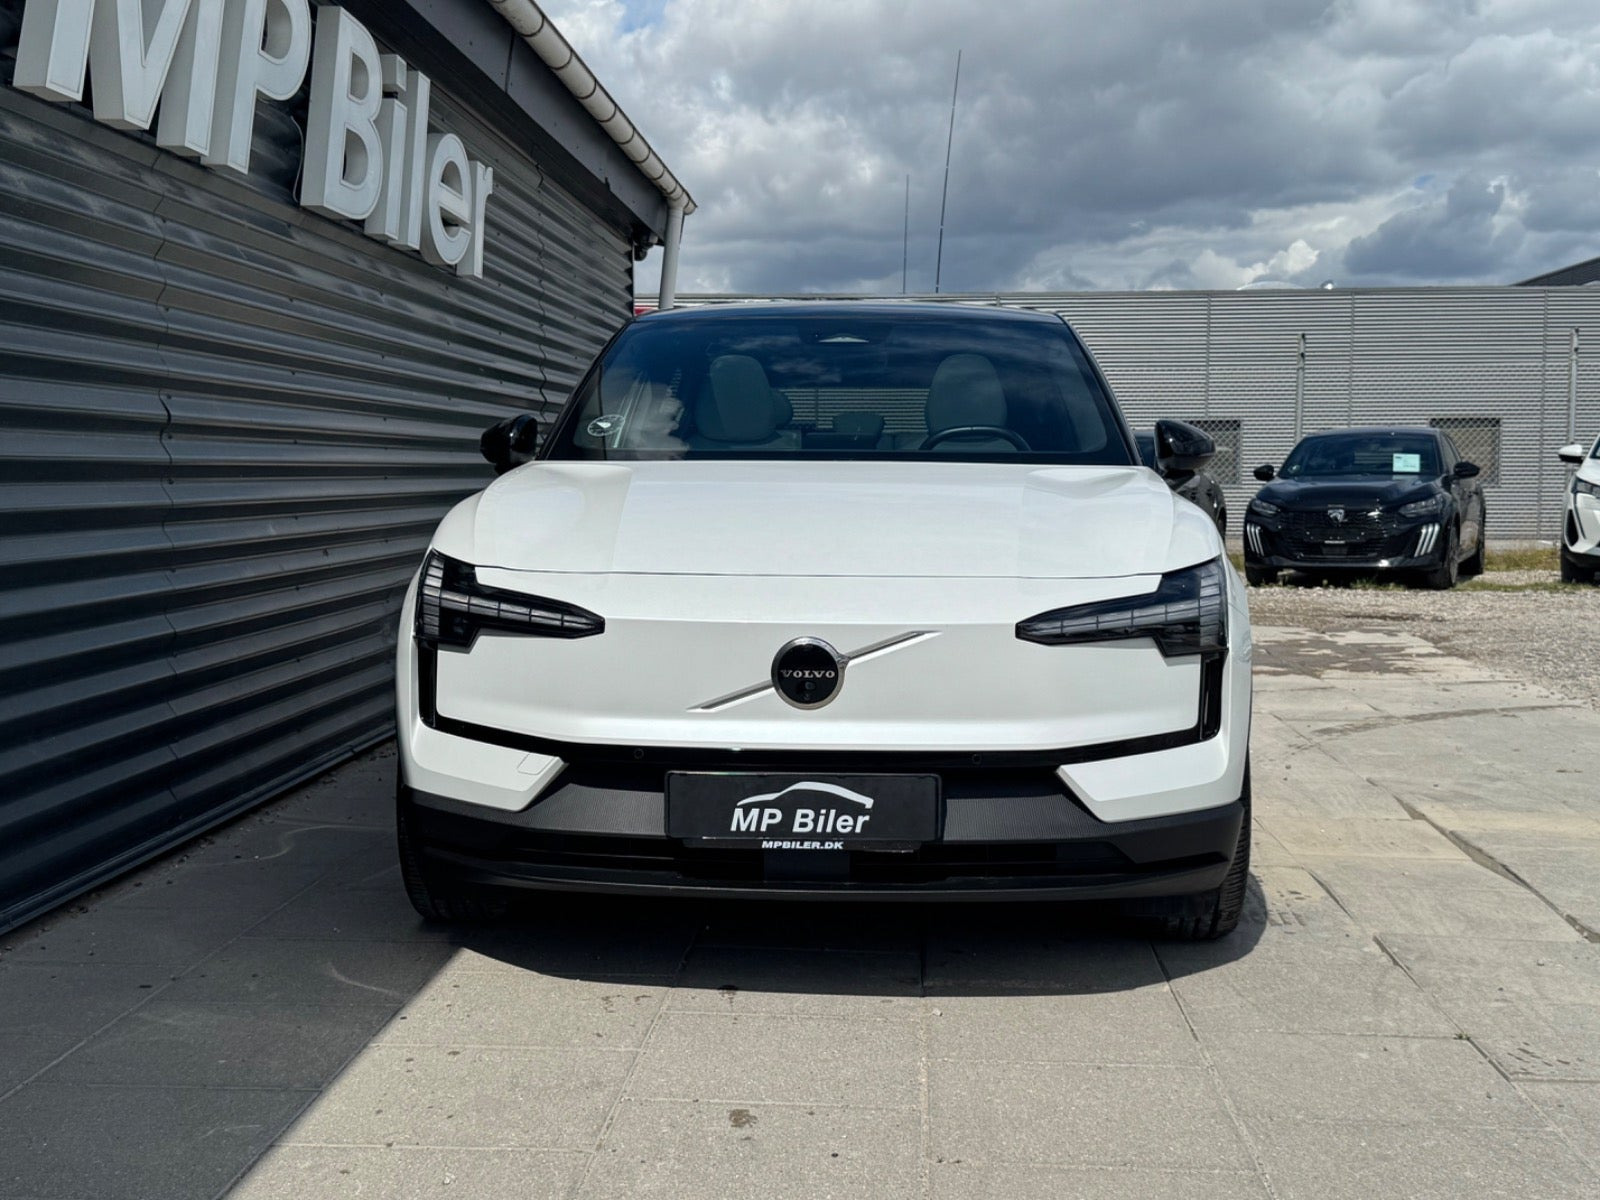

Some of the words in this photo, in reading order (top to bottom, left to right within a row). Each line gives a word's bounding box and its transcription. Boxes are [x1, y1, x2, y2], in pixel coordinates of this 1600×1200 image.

[780, 669, 836, 679] VOLVO
[730, 807, 783, 833] MP
[792, 808, 870, 834] Biler
[761, 840, 844, 850] MPBILER.DK
